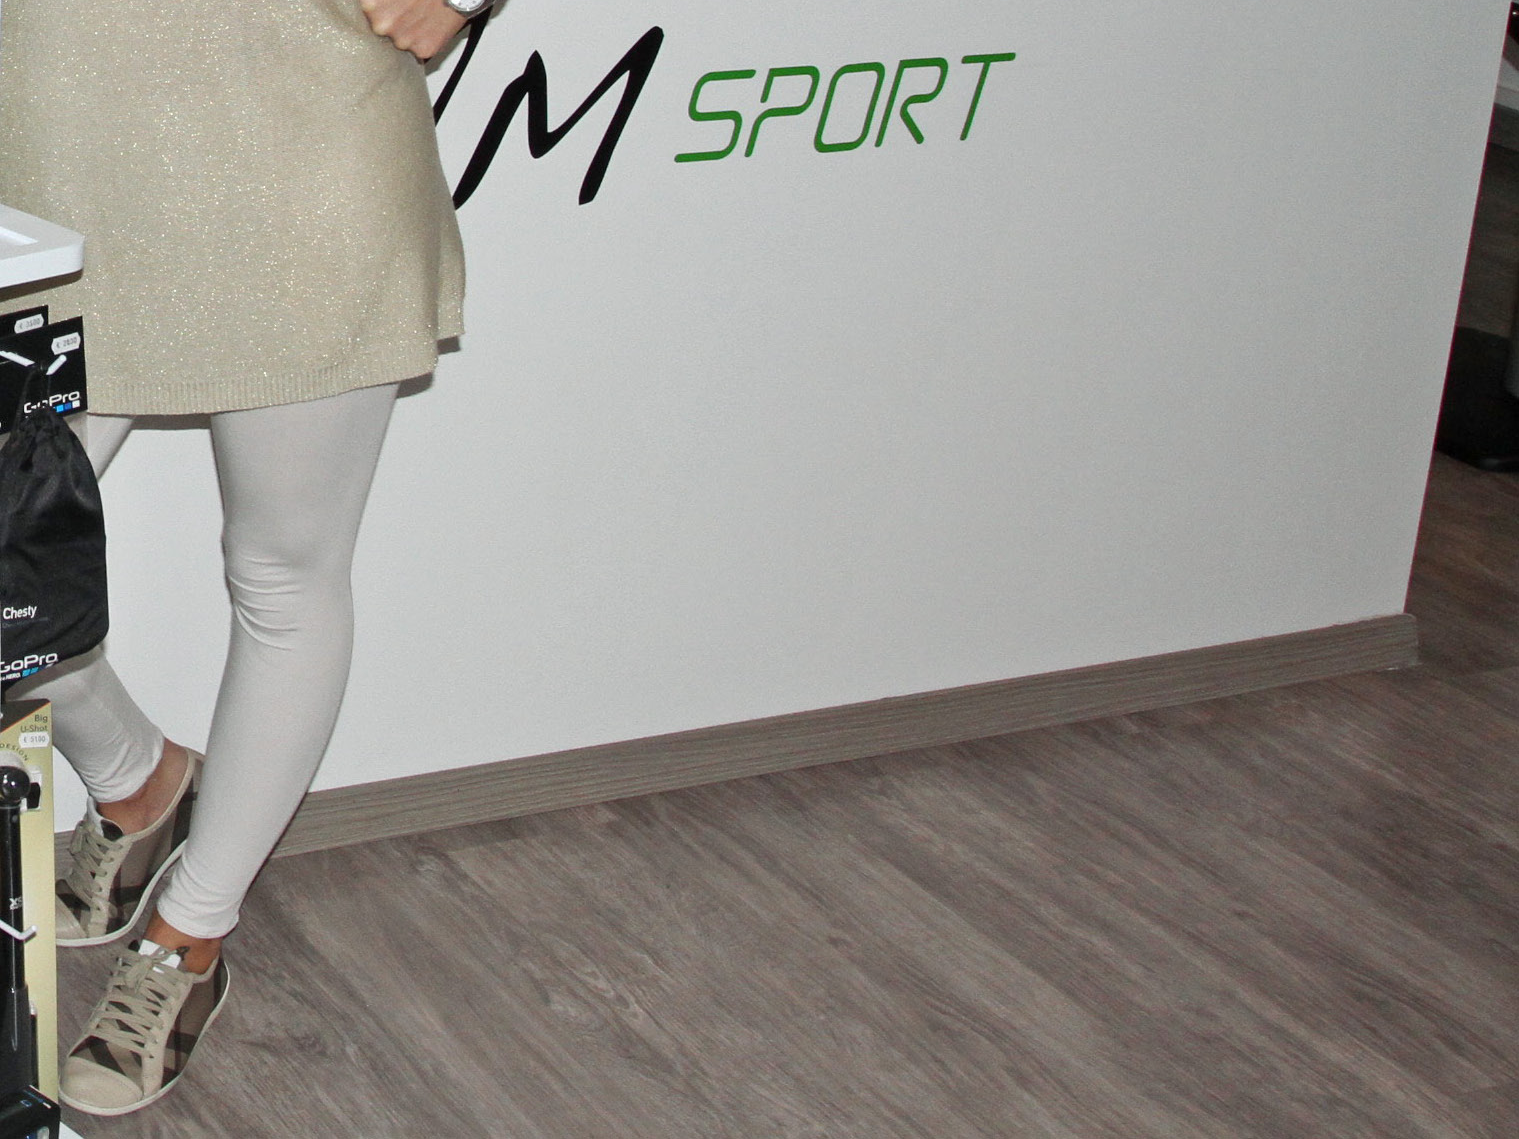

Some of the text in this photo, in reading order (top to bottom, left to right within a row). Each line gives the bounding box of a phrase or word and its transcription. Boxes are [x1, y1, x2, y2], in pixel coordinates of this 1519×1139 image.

[674, 51, 1016, 164] SPORT
[2, 604, 38, 621] Chesty
[0, 652, 59, 674] GoPro
[34, 714, 49, 723] Big
[20, 724, 48, 733] U-Shot
